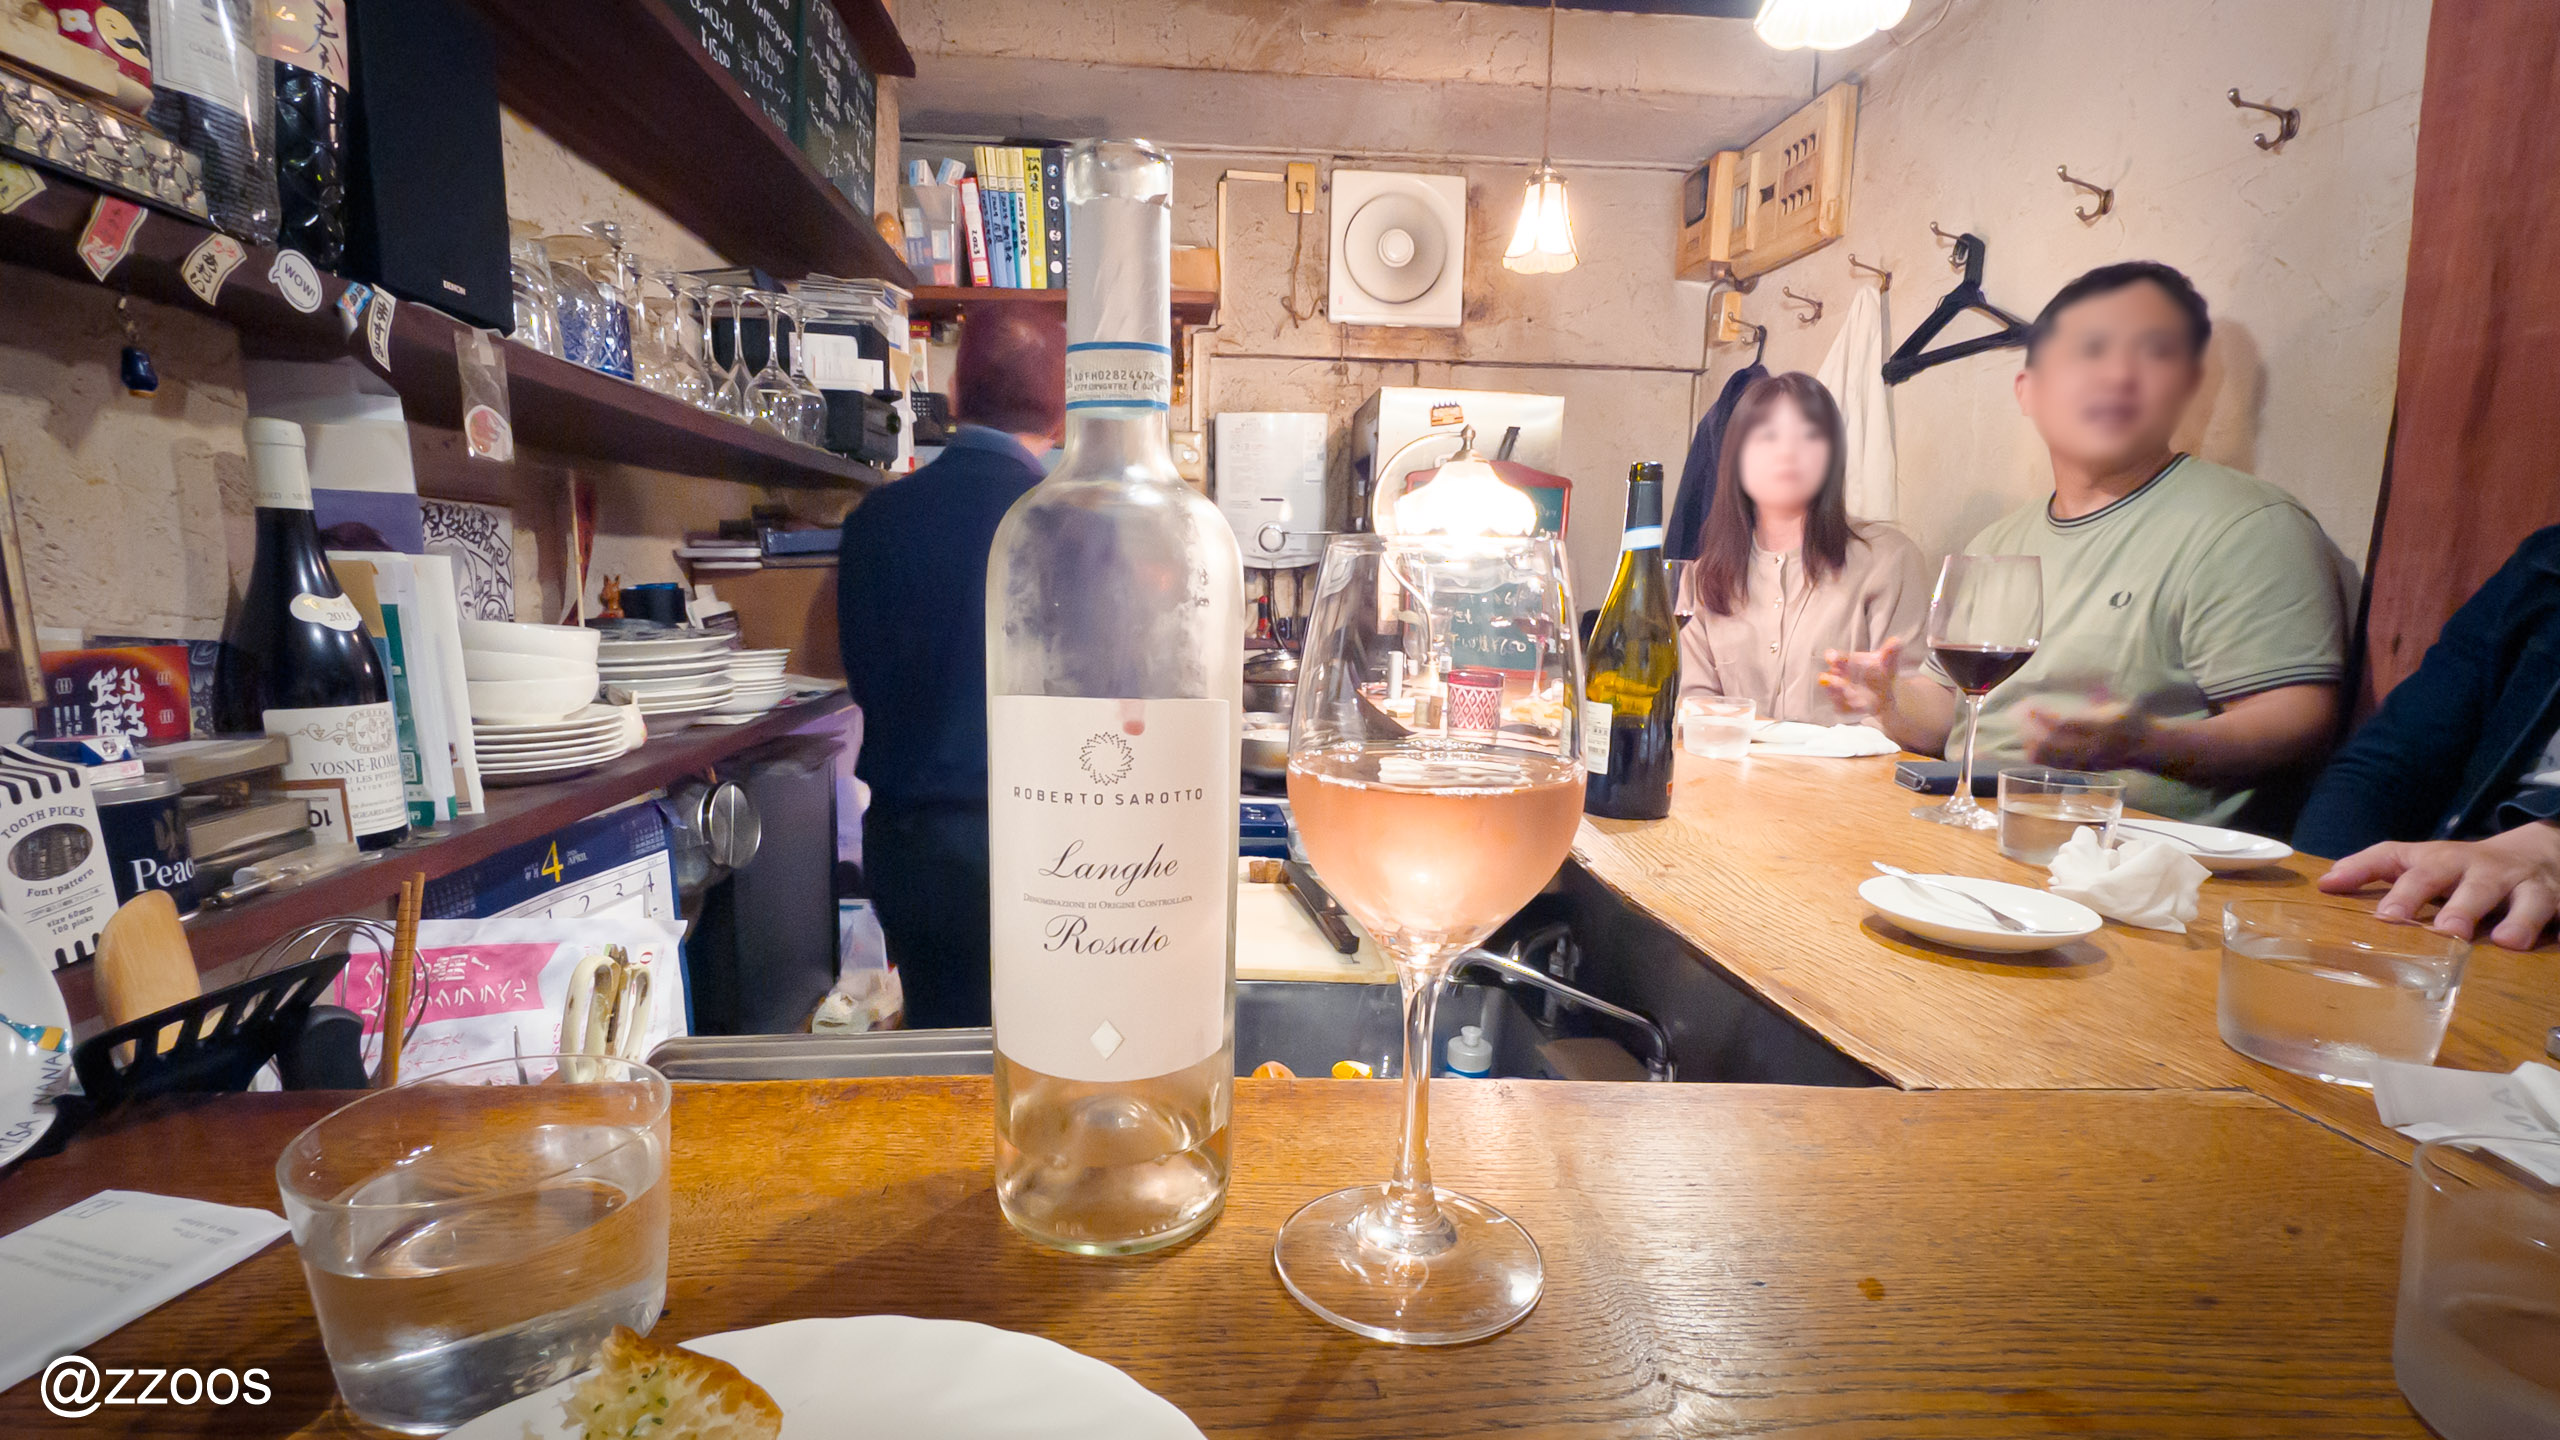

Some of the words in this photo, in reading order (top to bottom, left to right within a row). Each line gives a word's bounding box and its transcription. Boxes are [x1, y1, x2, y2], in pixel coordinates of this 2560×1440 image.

[971, 230, 980, 255] 2023
[284, 262, 317, 299] WOW!
[326, 611, 353, 622] 2015
[1013, 786, 1104, 806] ROBERTO
[1115, 787, 1203, 806] SAROTTO
[1, 808, 46, 840] TOOTH
[49, 805, 86, 818] PICKS
[541, 840, 564, 883] 4
[567, 852, 588, 865] APRIL
[1038, 839, 1179, 897] Langhe
[26, 887, 53, 897] Font
[57, 868, 94, 894] pattern
[47, 915, 66, 928] size
[67, 904, 93, 921] 60mm
[52, 922, 69, 935] 100
[71, 914, 95, 930] picks
[1043, 914, 1171, 955] Rosato
